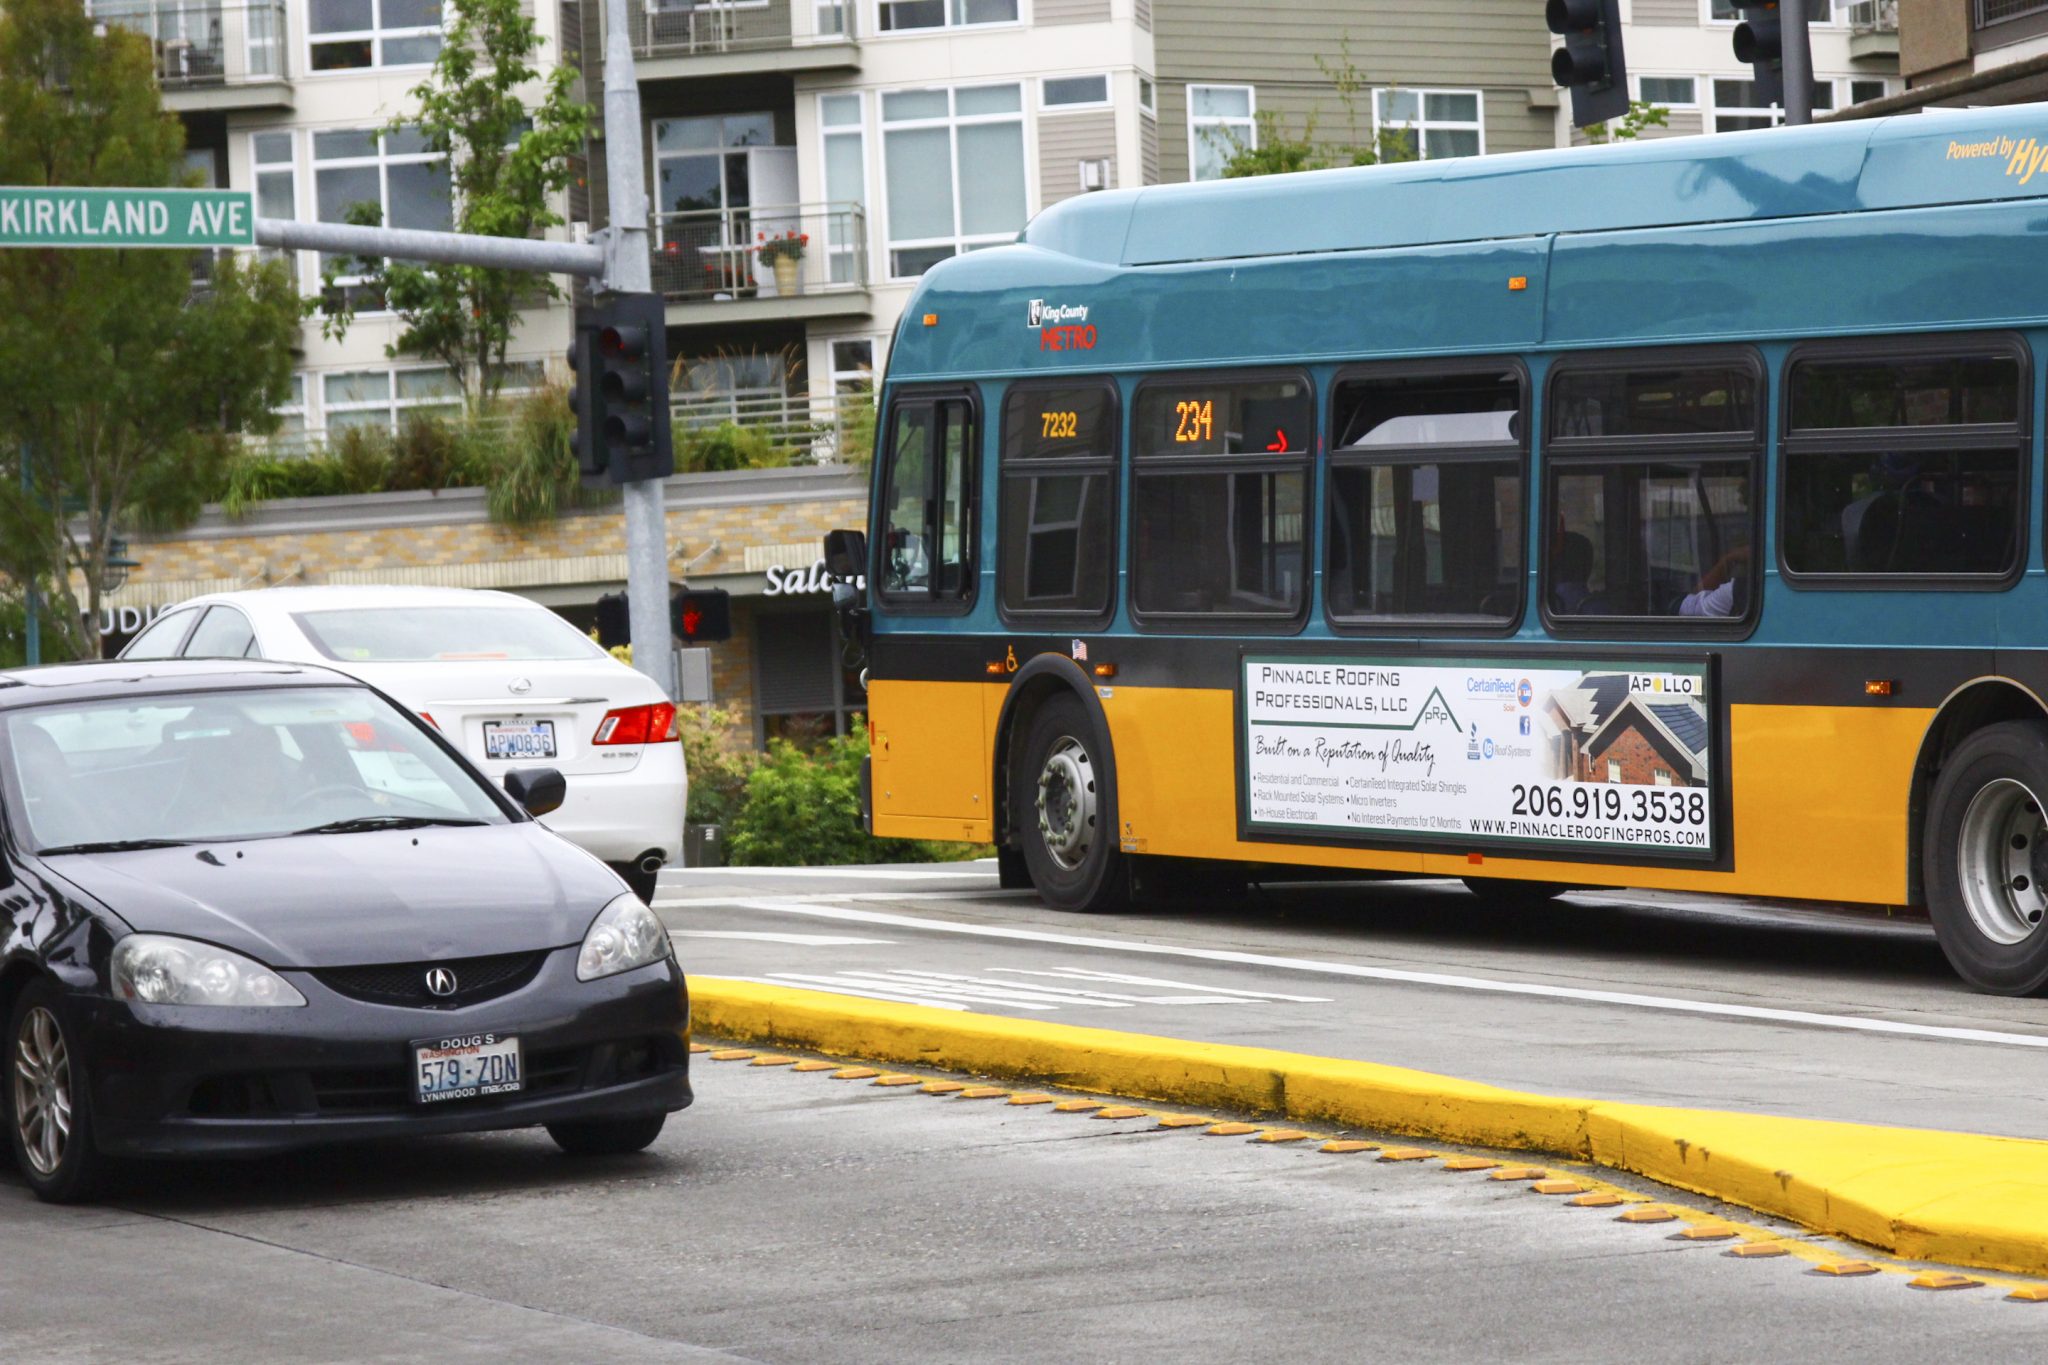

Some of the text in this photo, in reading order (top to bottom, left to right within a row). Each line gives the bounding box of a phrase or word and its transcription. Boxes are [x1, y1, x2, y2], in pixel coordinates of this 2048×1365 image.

[1946, 136, 2000, 160] Powered
[2000, 135, 2016, 160] by
[1, 198, 247, 236] KIRKLAND AVE
[1042, 304, 1089, 323] King County
[1040, 324, 1097, 352] METRO
[1041, 411, 1078, 438] 7232
[1175, 400, 1212, 441] 234
[1262, 666, 1400, 687] PINNACLE ROOFING
[1466, 677, 1516, 693] CertainTeed
[1631, 676, 1692, 693] APOLLO
[1256, 691, 1408, 714] PROFESSIONALS, LLC
[1255, 735, 1435, 777] Built on a Reputation of Quality
[1257, 772, 1339, 787] Residential and Commercial
[1349, 777, 1467, 795] CertainTeed Integrated Solar Shingles
[1258, 789, 1344, 806] Rack Mounted Solar Systems
[1350, 794, 1368, 806] Micro
[1511, 784, 1705, 826] 206.919.3538
[1286, 807, 1318, 820] Electrician
[1351, 812, 1462, 829] No Interest Payments for 12 Months
[1470, 818, 1706, 846] WWW.PINNACLEROOFINGPROS.COM
[441, 1033, 494, 1049] DOUG'S
[421, 1046, 480, 1060] WASHINGTON
[421, 1087, 476, 1103] LYNNWOOD
